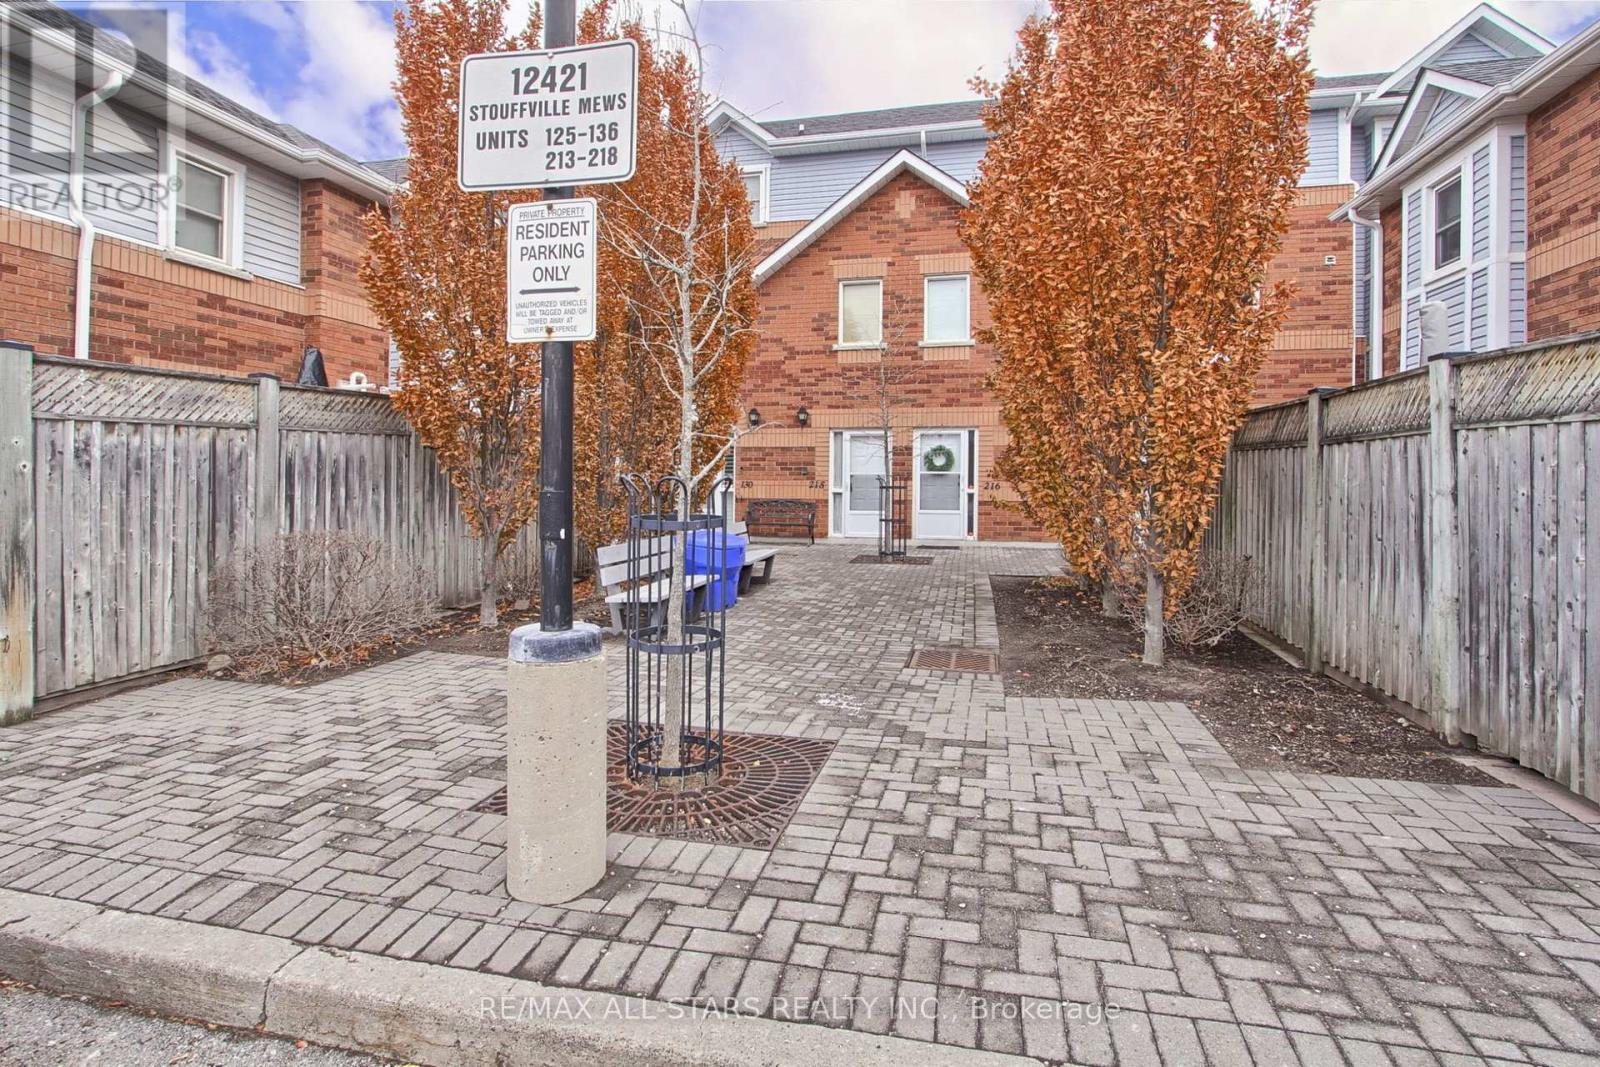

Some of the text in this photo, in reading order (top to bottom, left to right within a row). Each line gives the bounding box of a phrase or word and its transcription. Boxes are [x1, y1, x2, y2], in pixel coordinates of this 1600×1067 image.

[511, 62, 587, 96] 12421
[469, 92, 627, 122] STOUFFVILLE MEWS
[476, 121, 619, 150] UNITS 125-136
[545, 146, 618, 170] 213-218
[519, 206, 585, 219] PRIVATE PROPERTY
[516, 220, 590, 241] RESIDENT
[520, 242, 585, 262] PARKING
[532, 265, 571, 283] ONLY
[515, 299, 588, 309] UNAUTHORIZED VEHICLES
[515, 309, 528, 317] WILL
[529, 309, 537, 317] BE
[539, 308, 562, 316] TAGGED
[528, 317, 548, 325] TOWED
[984, 481, 1001, 490] 216
